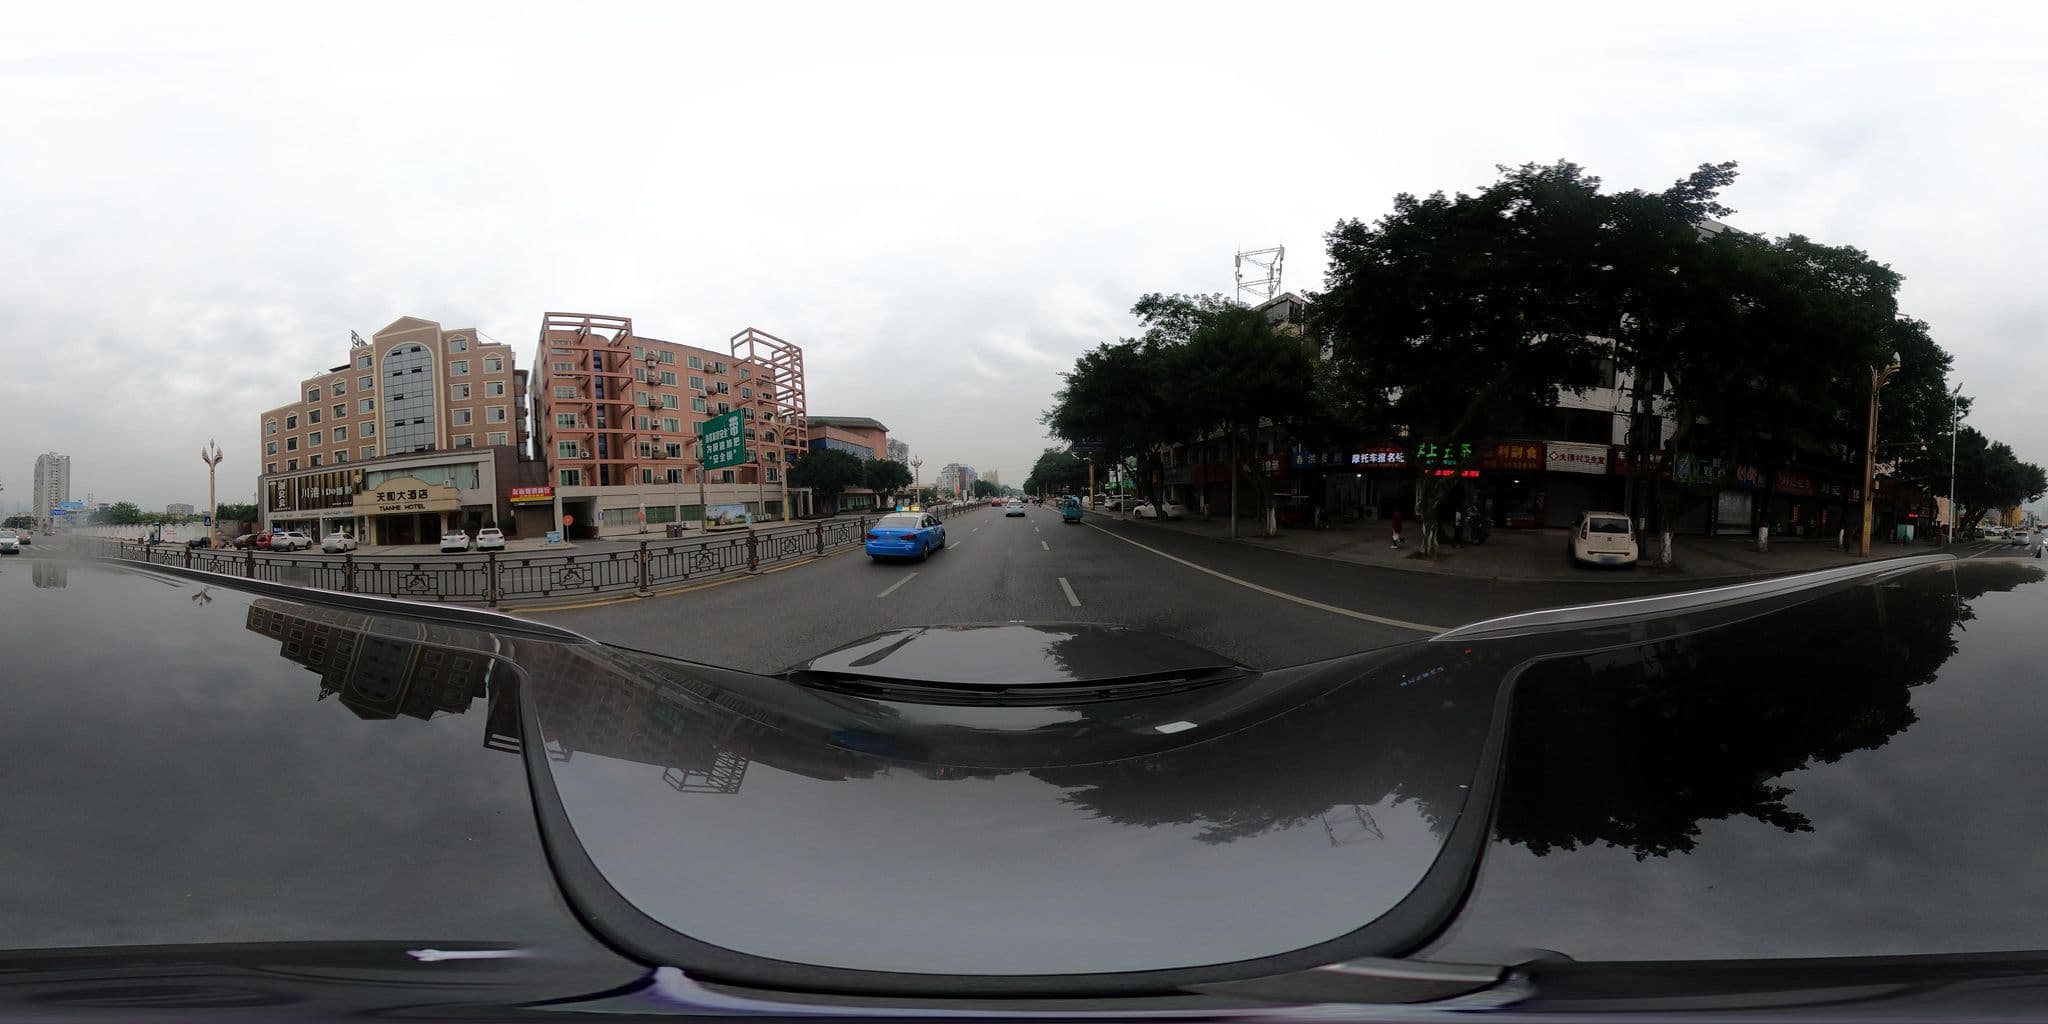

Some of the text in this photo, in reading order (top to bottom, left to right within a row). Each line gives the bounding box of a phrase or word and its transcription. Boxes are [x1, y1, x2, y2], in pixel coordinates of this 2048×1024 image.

[1351, 452, 1405, 464] 摩托车报名处
[379, 503, 426, 512] TIANHE HOTEL
